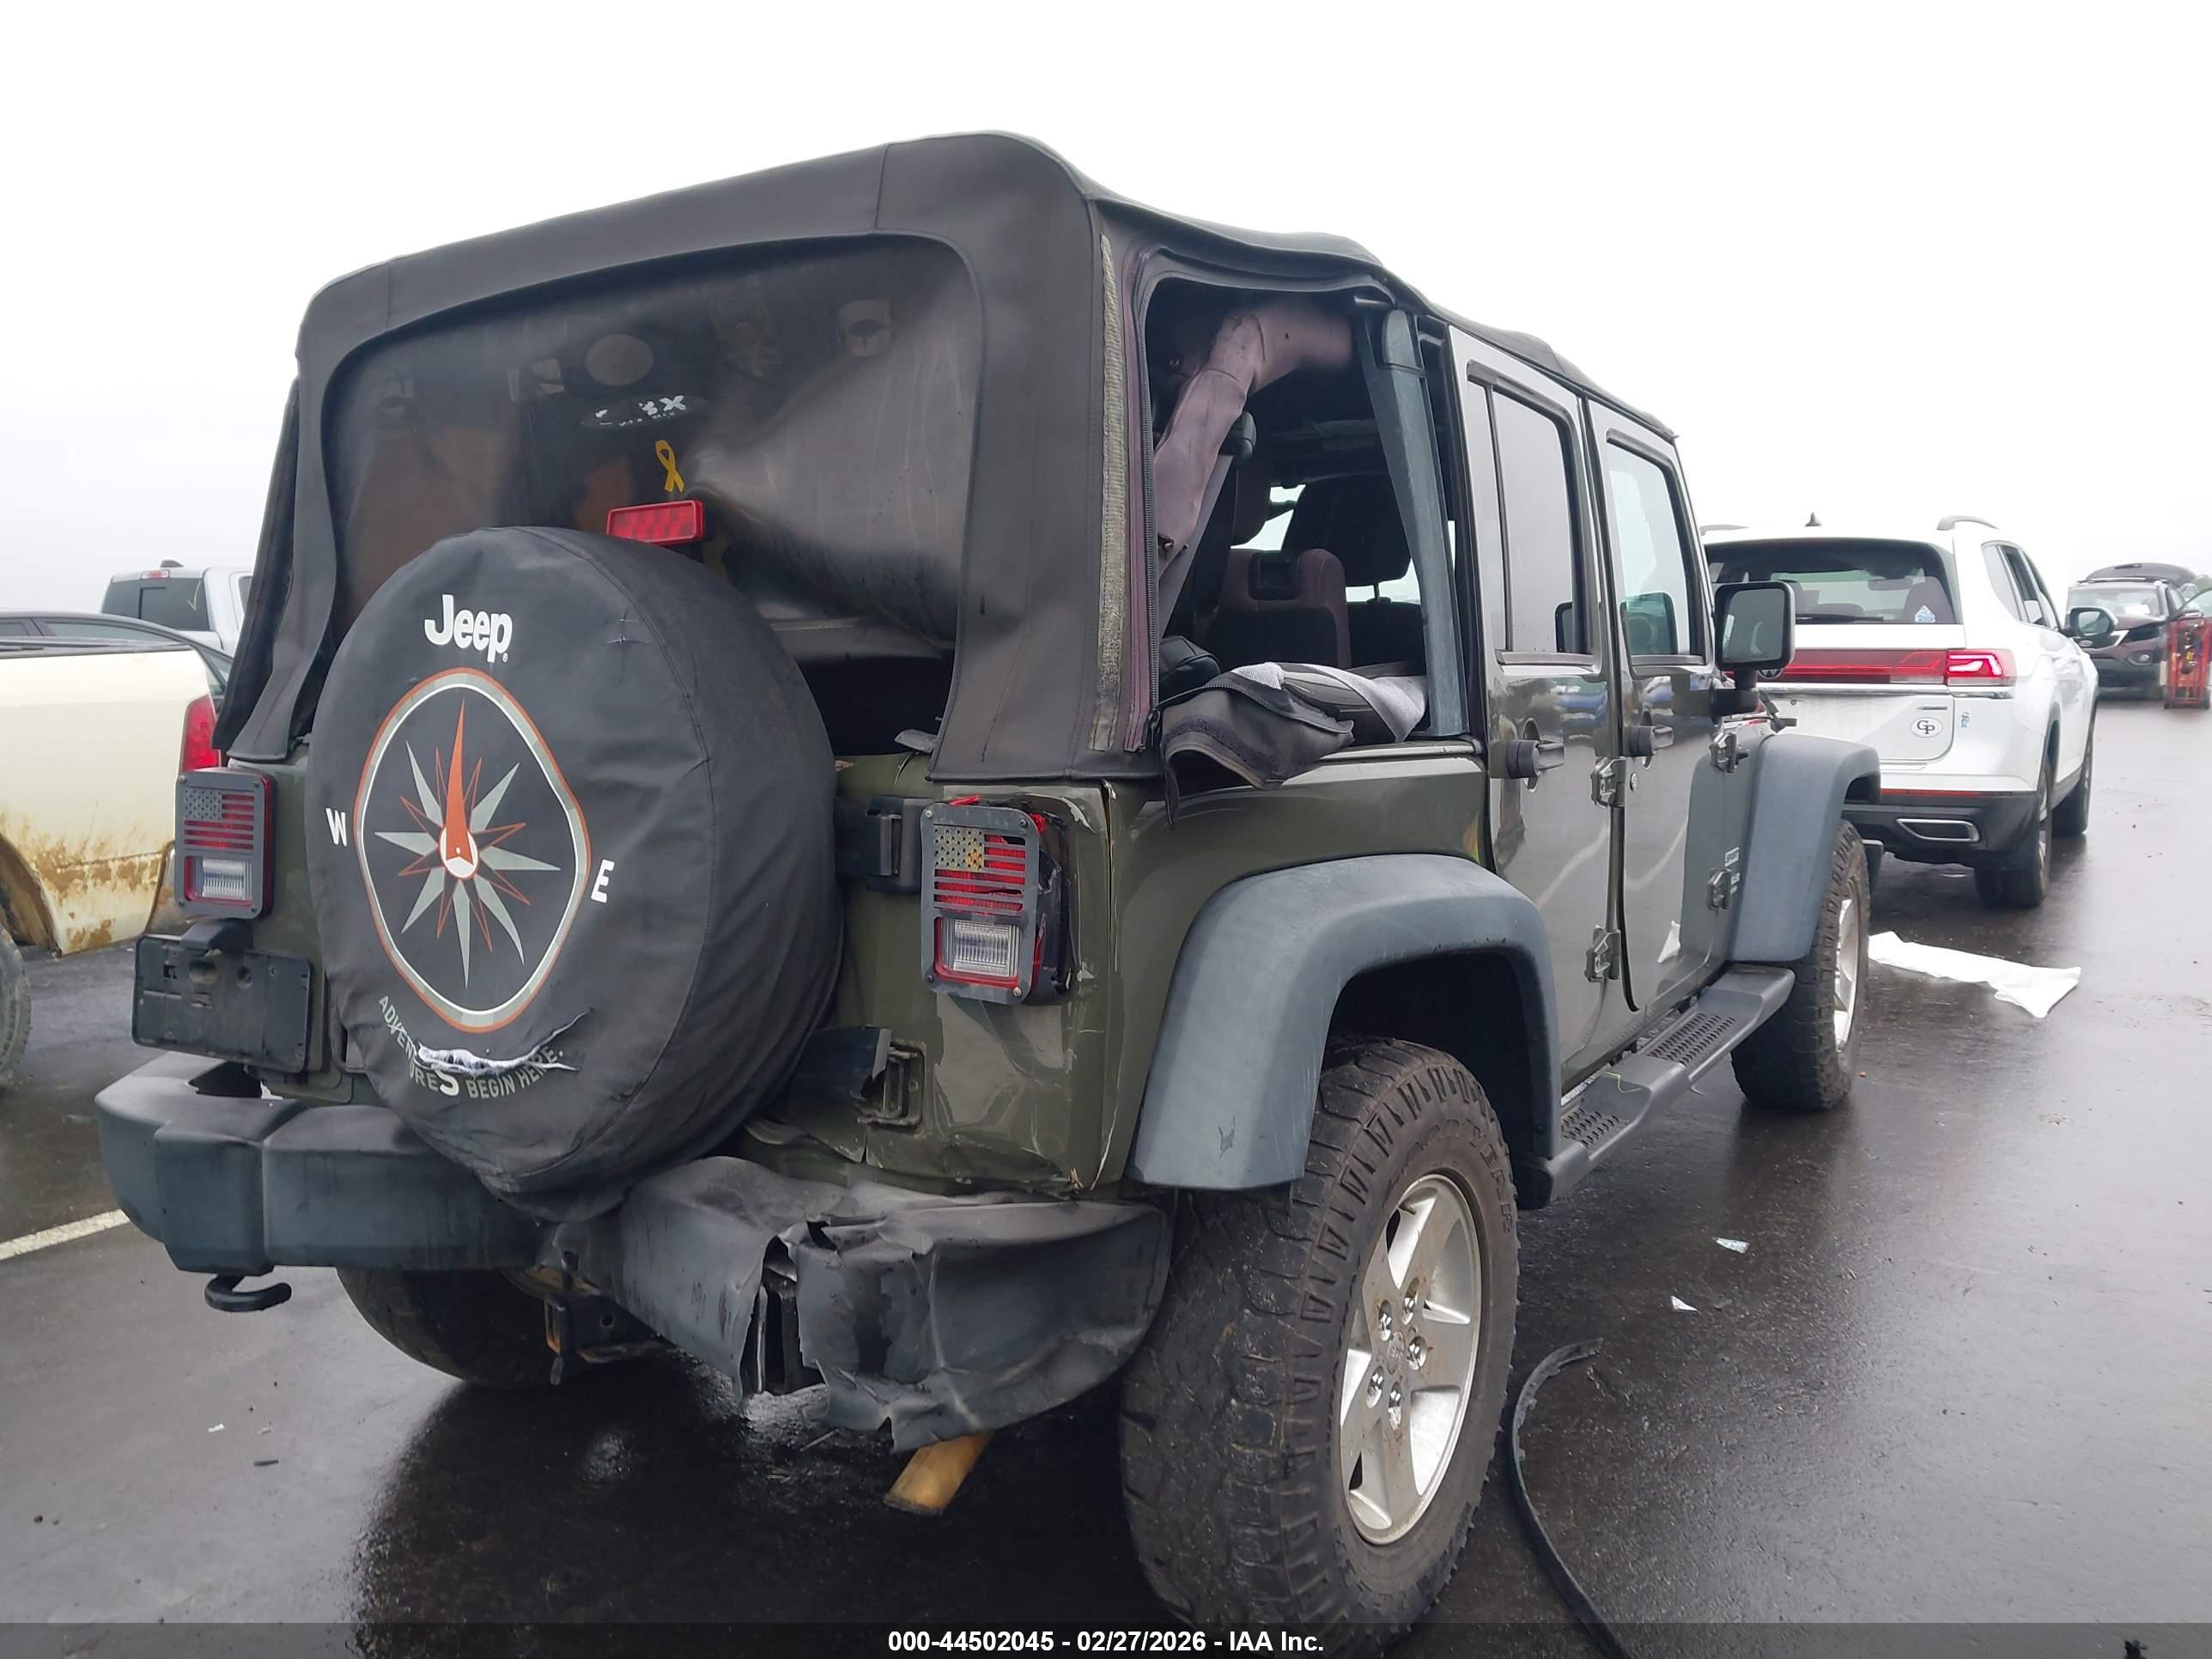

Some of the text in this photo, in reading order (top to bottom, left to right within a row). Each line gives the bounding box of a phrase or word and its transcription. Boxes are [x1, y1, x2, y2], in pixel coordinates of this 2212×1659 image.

[423, 593, 513, 663] Jeep
[325, 807, 348, 847] W
[591, 859, 615, 903] E
[379, 995, 459, 1097] ADVENURES
[465, 1073, 515, 1099] BEGIN
